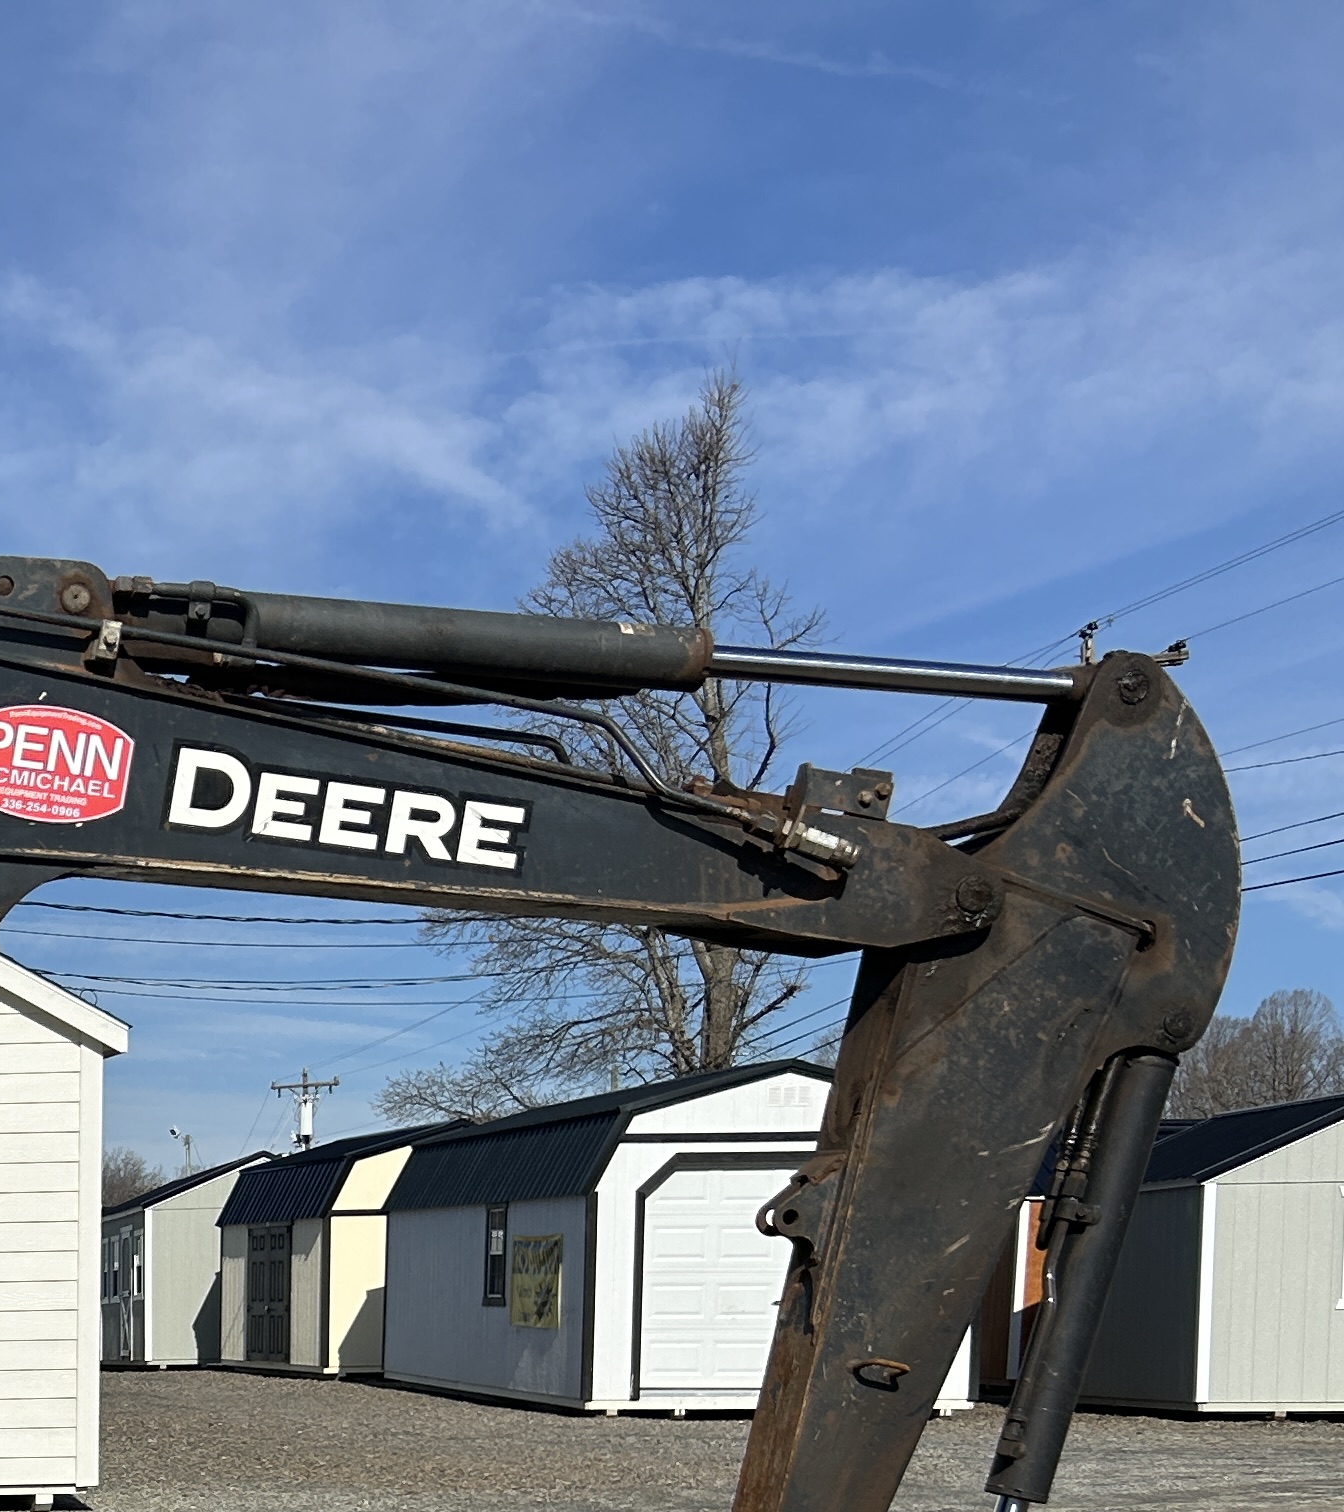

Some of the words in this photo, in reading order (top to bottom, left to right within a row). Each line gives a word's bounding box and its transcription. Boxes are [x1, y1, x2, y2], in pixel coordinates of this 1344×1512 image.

[0, 786, 48, 801] EQUIPMENT
[50, 792, 88, 806] TRADING
[1, 797, 81, 818] 336-254-0906
[168, 747, 526, 870] DEERE
